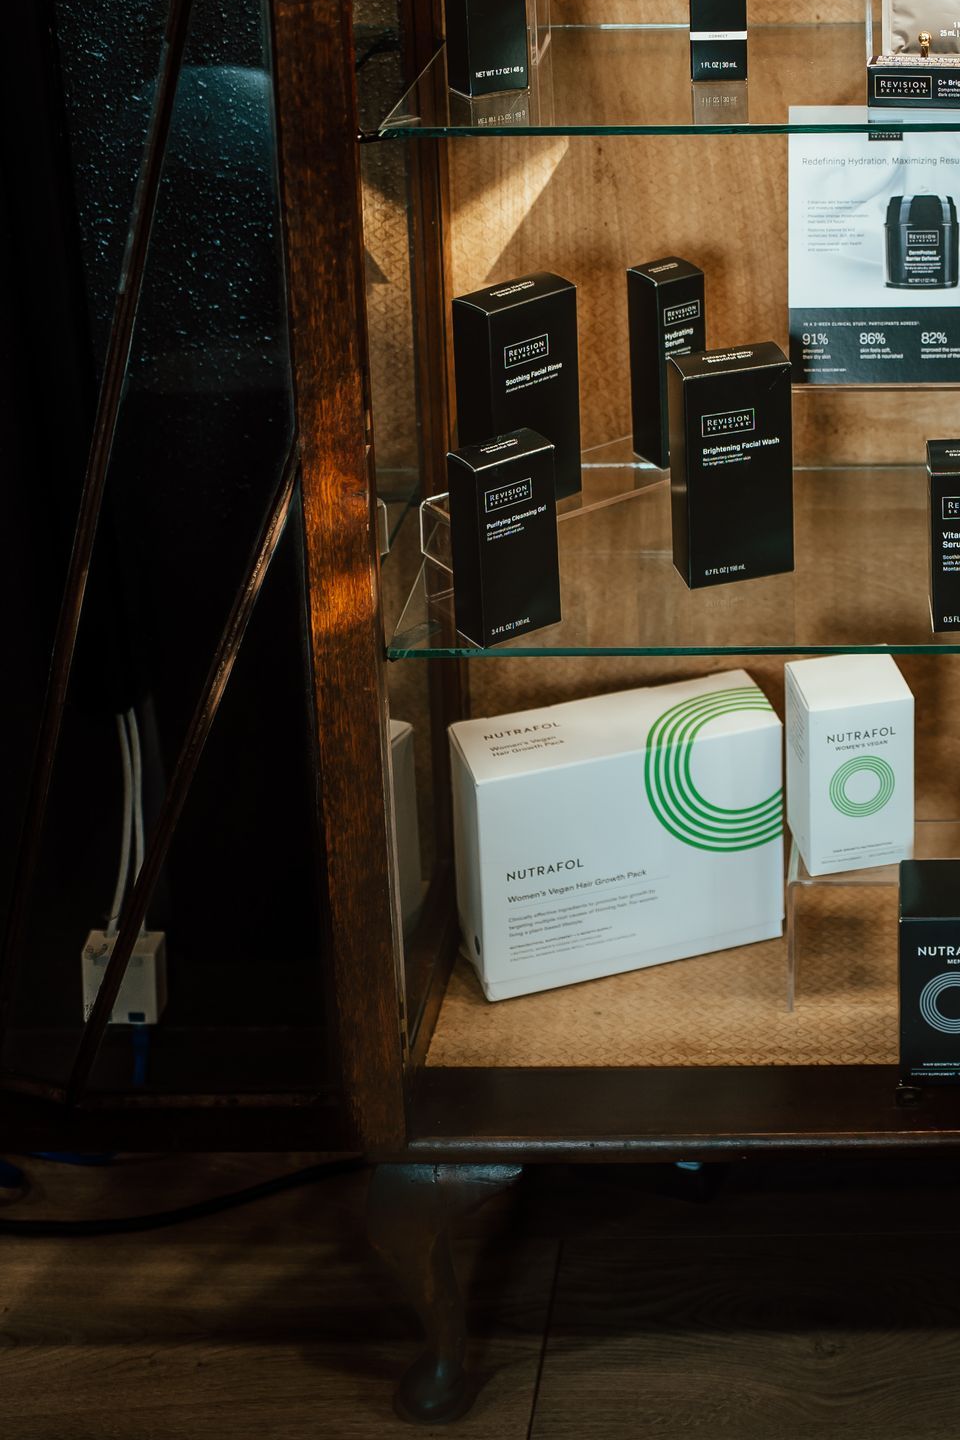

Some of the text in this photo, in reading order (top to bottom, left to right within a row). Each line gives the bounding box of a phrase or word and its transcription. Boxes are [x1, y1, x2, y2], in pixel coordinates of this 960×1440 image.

[880, 80, 927, 89] REVISION
[802, 158, 846, 166] Redefining
[848, 157, 889, 166] Hydration,
[892, 156, 937, 166] Maximizing
[668, 305, 697, 317] REVISION
[665, 327, 694, 341] Hydrating
[803, 332, 947, 345] 91% 86% 82%
[509, 340, 545, 357] REVISION
[665, 337, 685, 348] Serum
[505, 372, 530, 386] Soothing
[530, 366, 547, 379] Facial
[547, 362, 563, 373] Rinse
[707, 415, 750, 426] REVISION
[703, 437, 780, 455] Brightening Facial Wash
[490, 485, 527, 501] REVISION
[487, 517, 511, 529] Purifying
[512, 510, 537, 521] Cleansing
[484, 721, 561, 741] NUTRAFOL
[827, 726, 896, 744] NUTRAFOL
[835, 743, 865, 751] WOMEN'S
[506, 859, 584, 882] NUTRAFOL
[507, 870, 647, 903] Women's Vegan Hair Growth Pack
